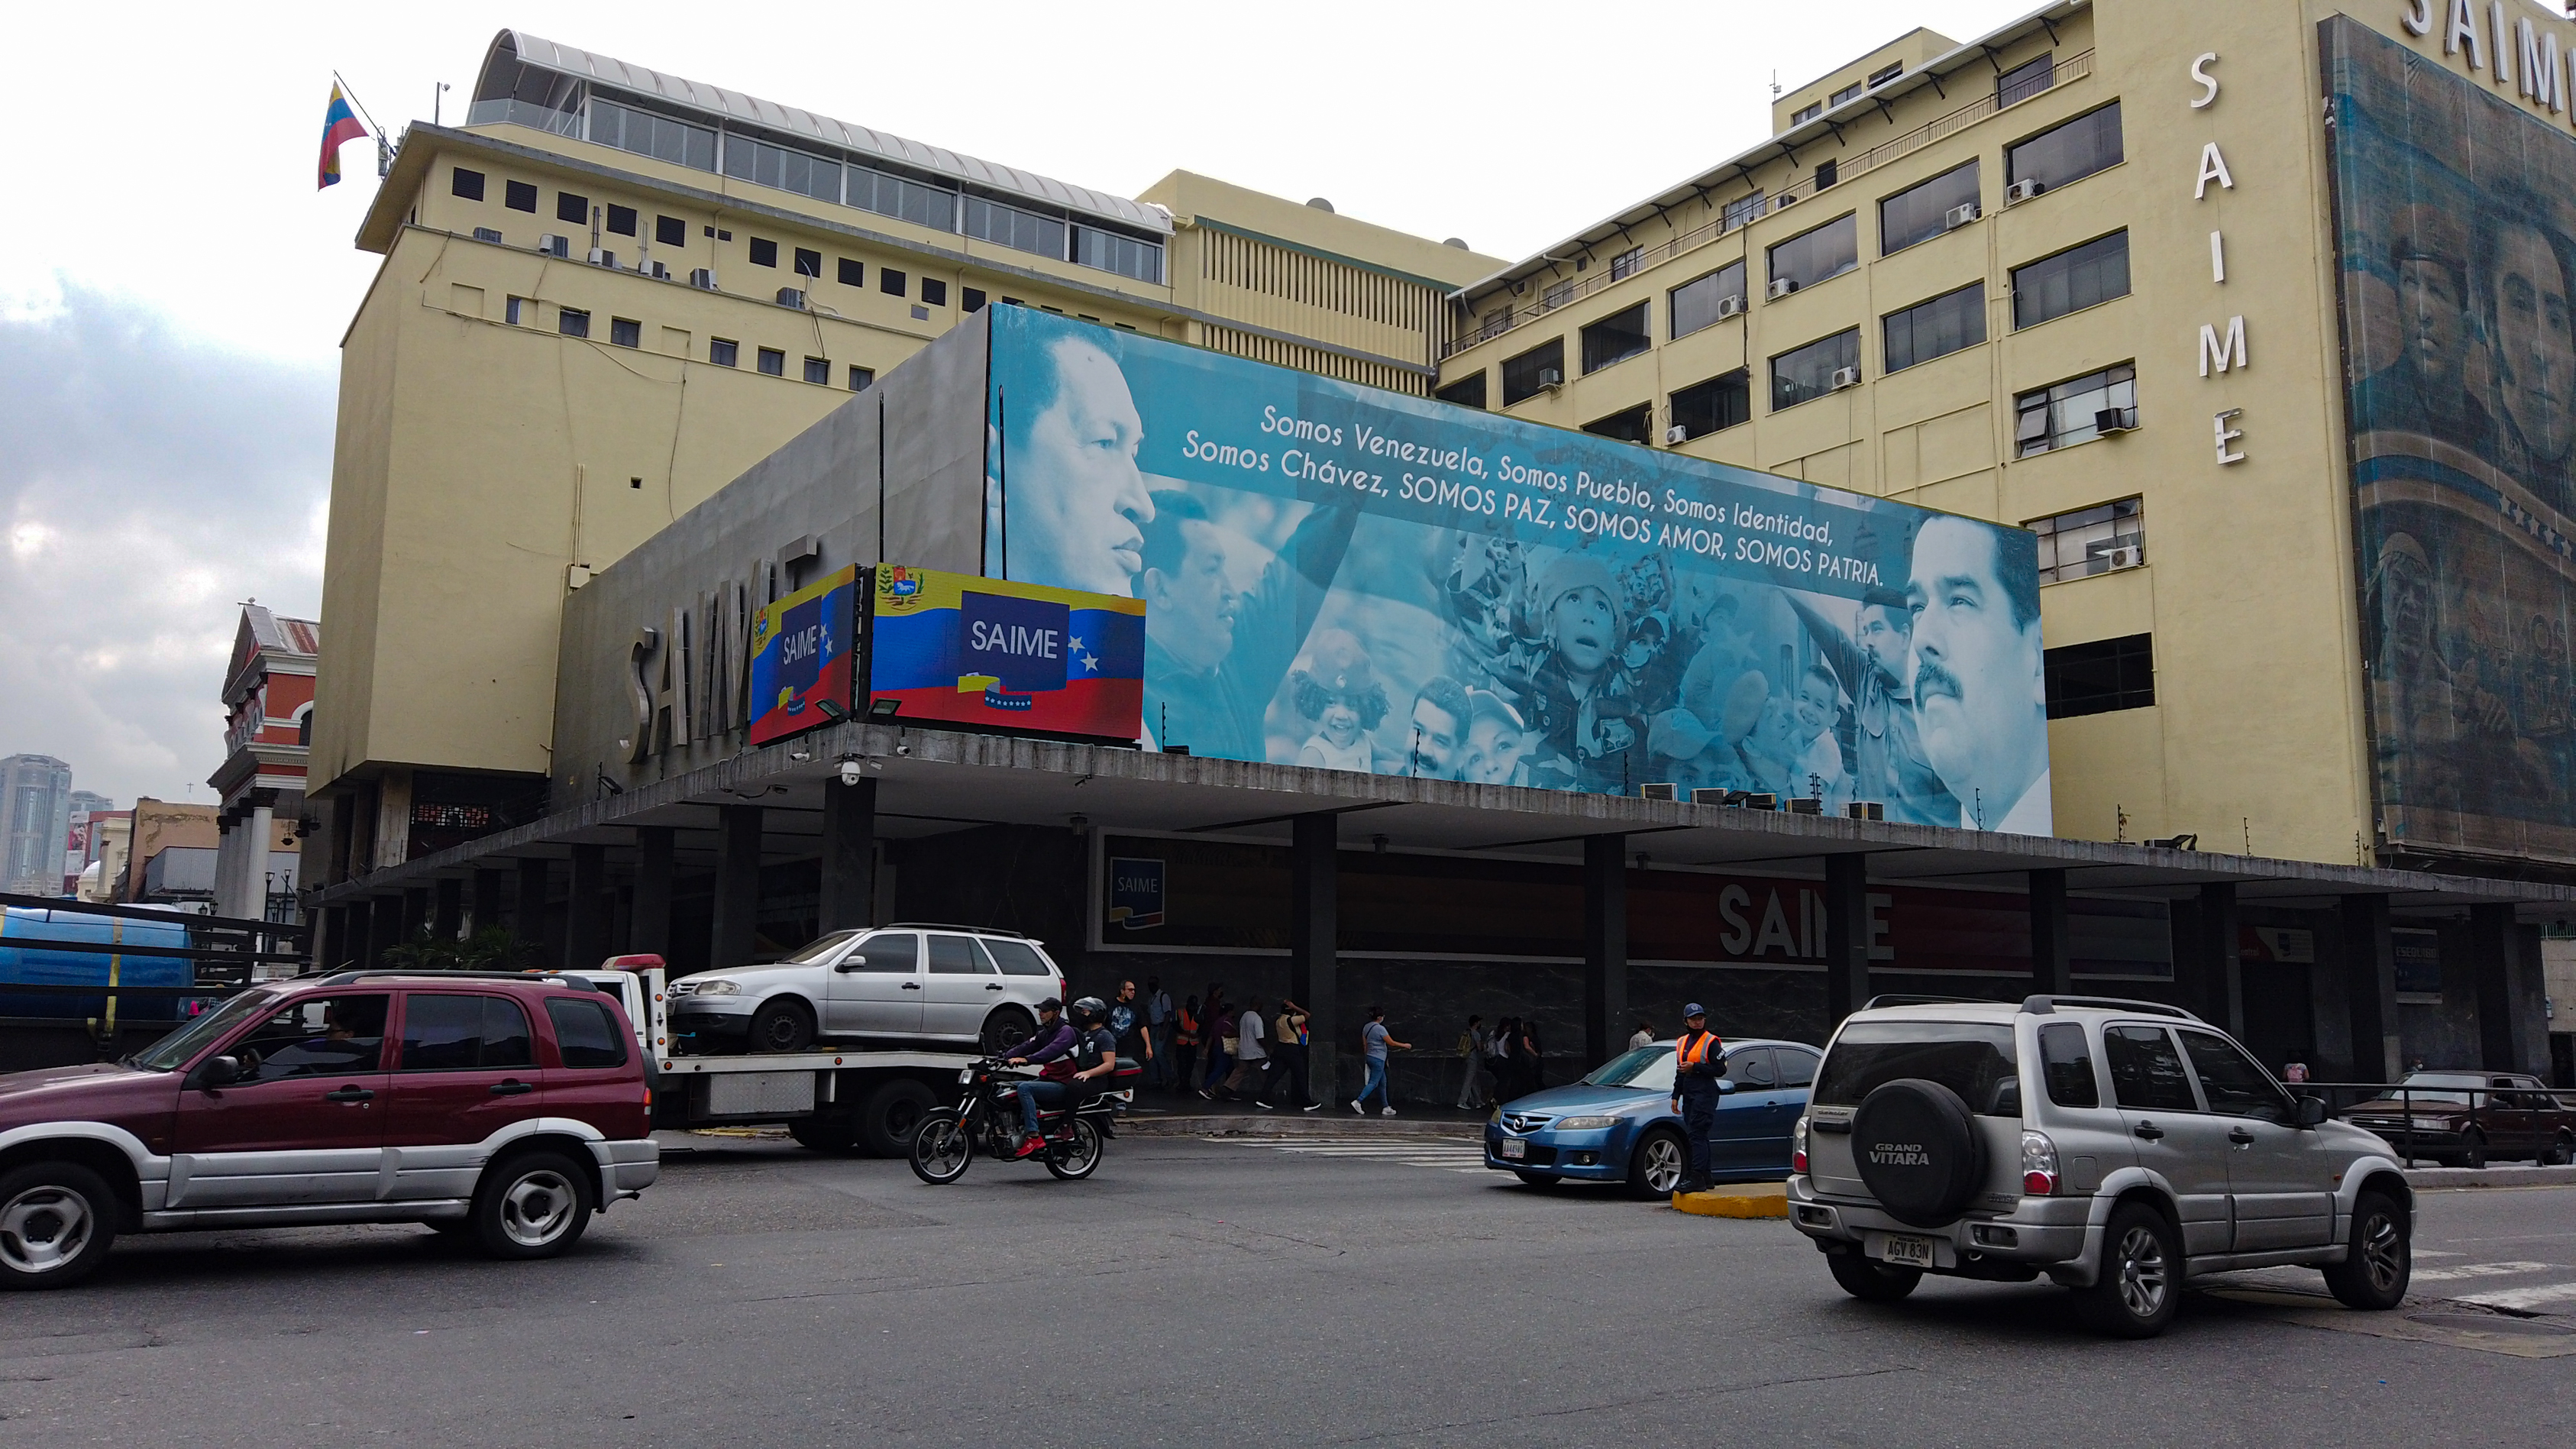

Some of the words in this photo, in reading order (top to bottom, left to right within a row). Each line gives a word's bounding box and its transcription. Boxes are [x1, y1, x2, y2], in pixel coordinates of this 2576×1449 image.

[2190, 51, 2248, 466] SAIME
[1260, 405, 1343, 446] Somos
[1355, 423, 1488, 480] Venezuela,
[1498, 454, 1568, 493] Somos
[1576, 471, 1656, 513] Pueblo,
[1663, 488, 1726, 523] Somos
[1733, 502, 1833, 547] Identidad,
[1182, 429, 1270, 472] Somos
[1281, 449, 1389, 498] Chávez,
[1399, 472, 1496, 516] SOMOS
[1504, 492, 1556, 529] PAZ,
[1563, 504, 1652, 544] SOMOS
[1656, 522, 1728, 561] AMOR,
[1734, 536, 1812, 573] SOMOS
[1818, 552, 1884, 587] PATRIA.
[783, 625, 817, 665] SAIME
[971, 620, 1059, 659] SAIME
[1117, 876, 1159, 893] SAIME
[1869, 1150, 1930, 1166] VITARA
[1874, 1143, 1923, 1153] GRAND
[1887, 1240, 1907, 1257] AGV
[1909, 1243, 1930, 1260] 83N
